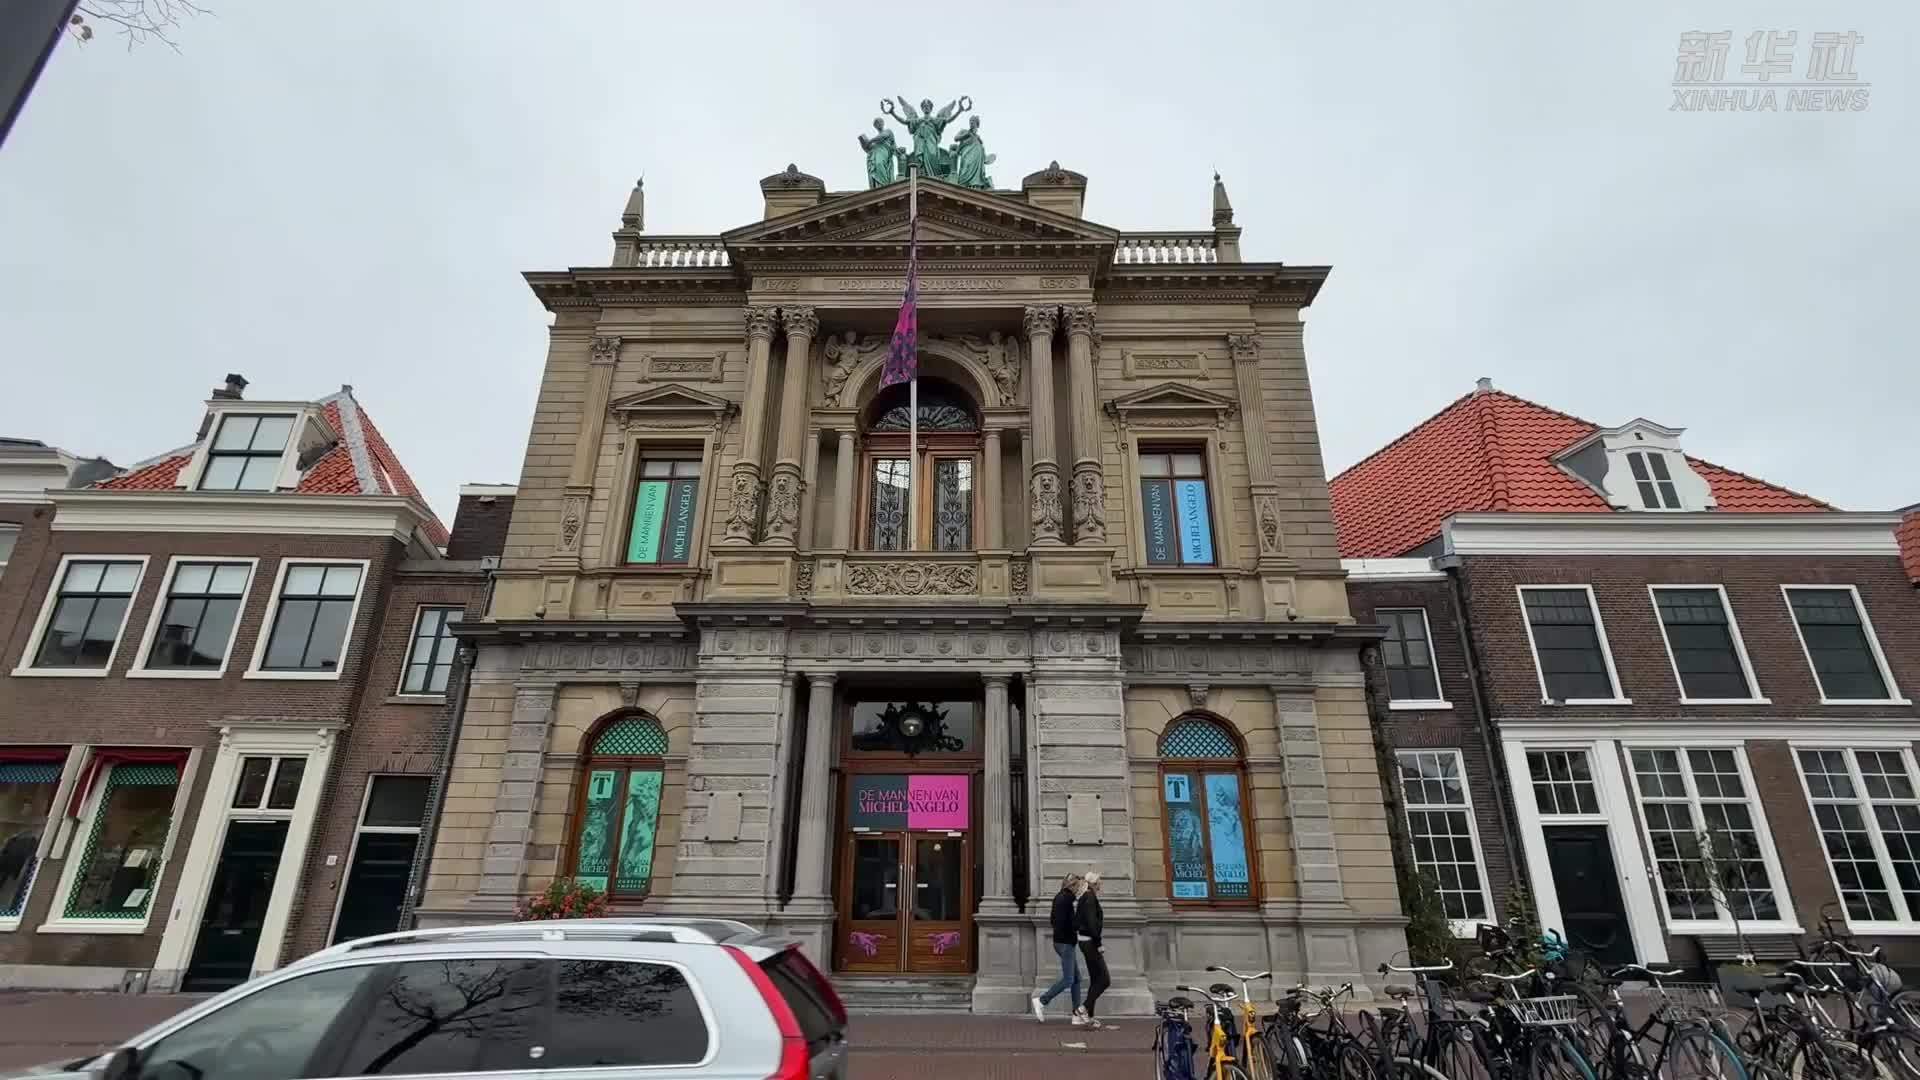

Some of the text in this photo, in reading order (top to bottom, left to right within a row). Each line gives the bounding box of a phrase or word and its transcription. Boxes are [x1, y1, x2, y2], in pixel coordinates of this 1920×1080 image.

[638, 485, 657, 559] DE MANNEN VAN
[673, 484, 693, 559] MICHELANGELO
[1151, 484, 1167, 560] DE MANNEN VAN
[1186, 483, 1203, 560] MICHELANGELO
[593, 777, 611, 795] T
[858, 789, 959, 801] DE MANNEN VAN
[858, 801, 959, 813] MICHELANGELO
[1167, 780, 1185, 798] T
